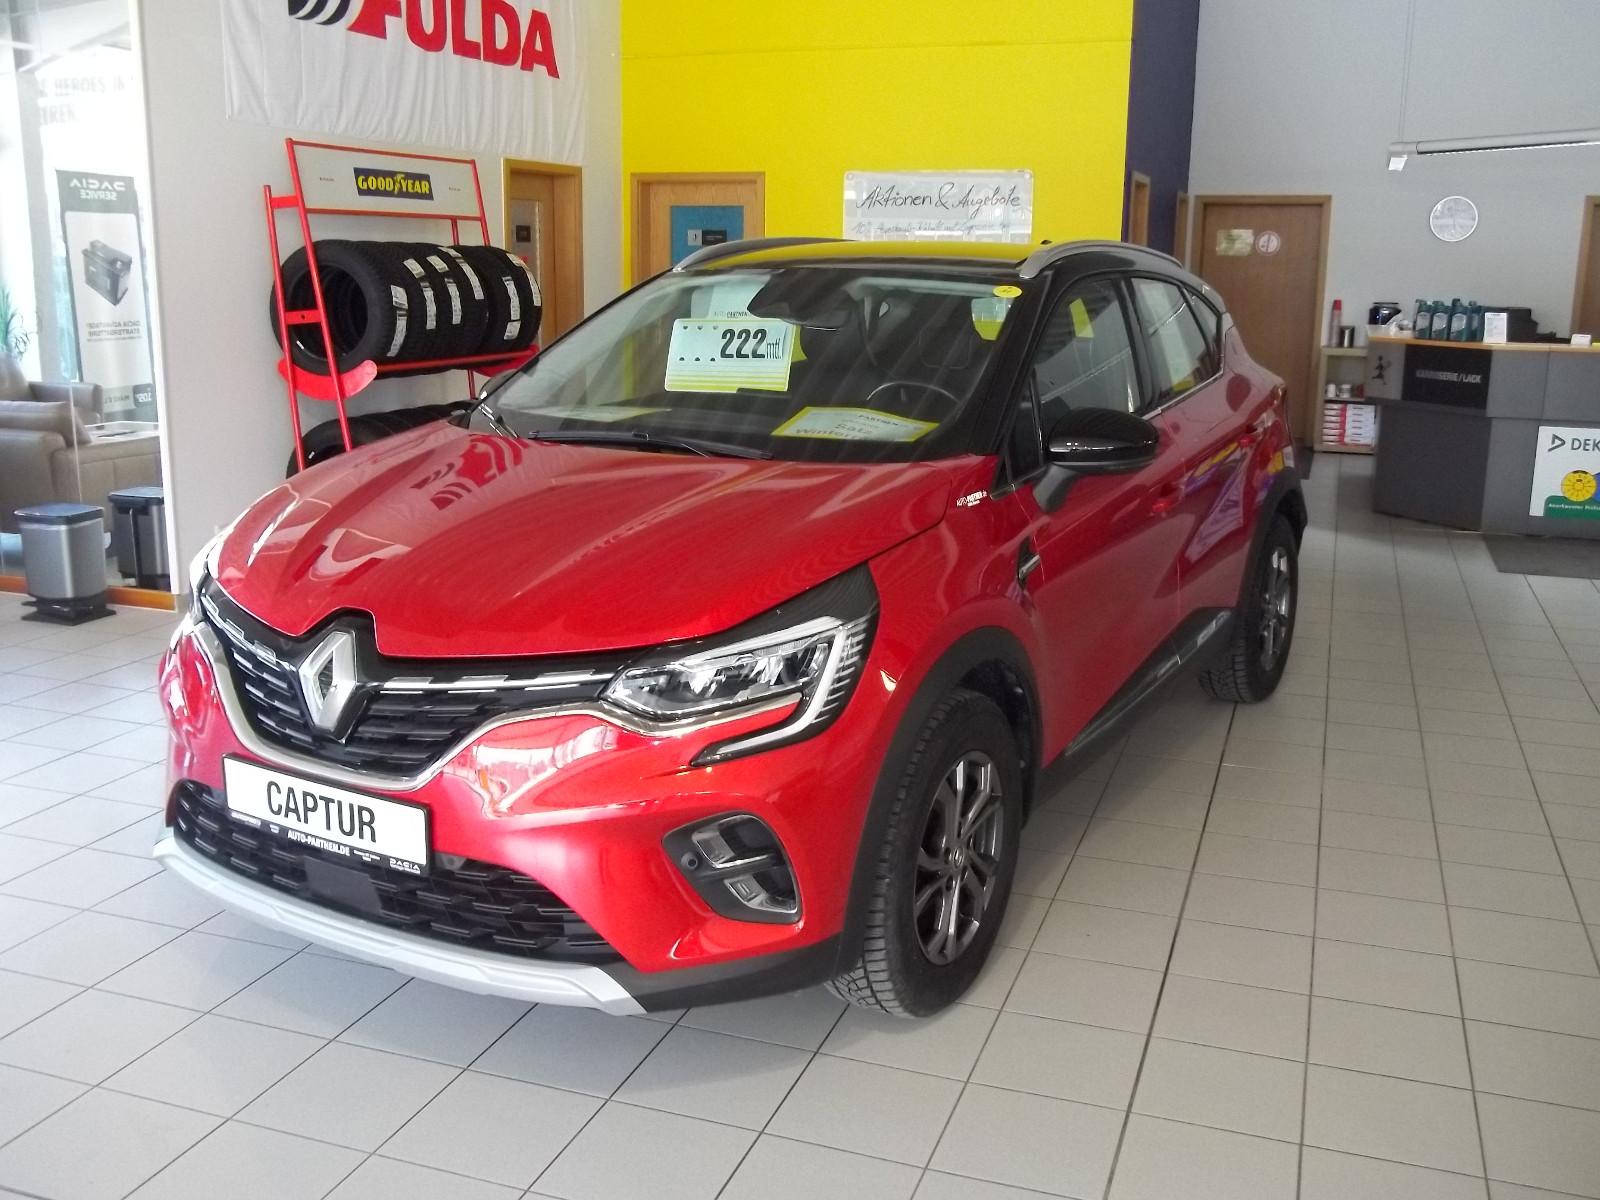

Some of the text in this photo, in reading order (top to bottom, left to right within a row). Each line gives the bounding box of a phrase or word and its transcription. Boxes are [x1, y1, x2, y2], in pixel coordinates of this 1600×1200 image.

[347, 0, 559, 79] FULDA
[856, 182, 1021, 219] Aktionen & Angebote
[720, 328, 768, 359] 222
[266, 780, 377, 843] CAPTUR
